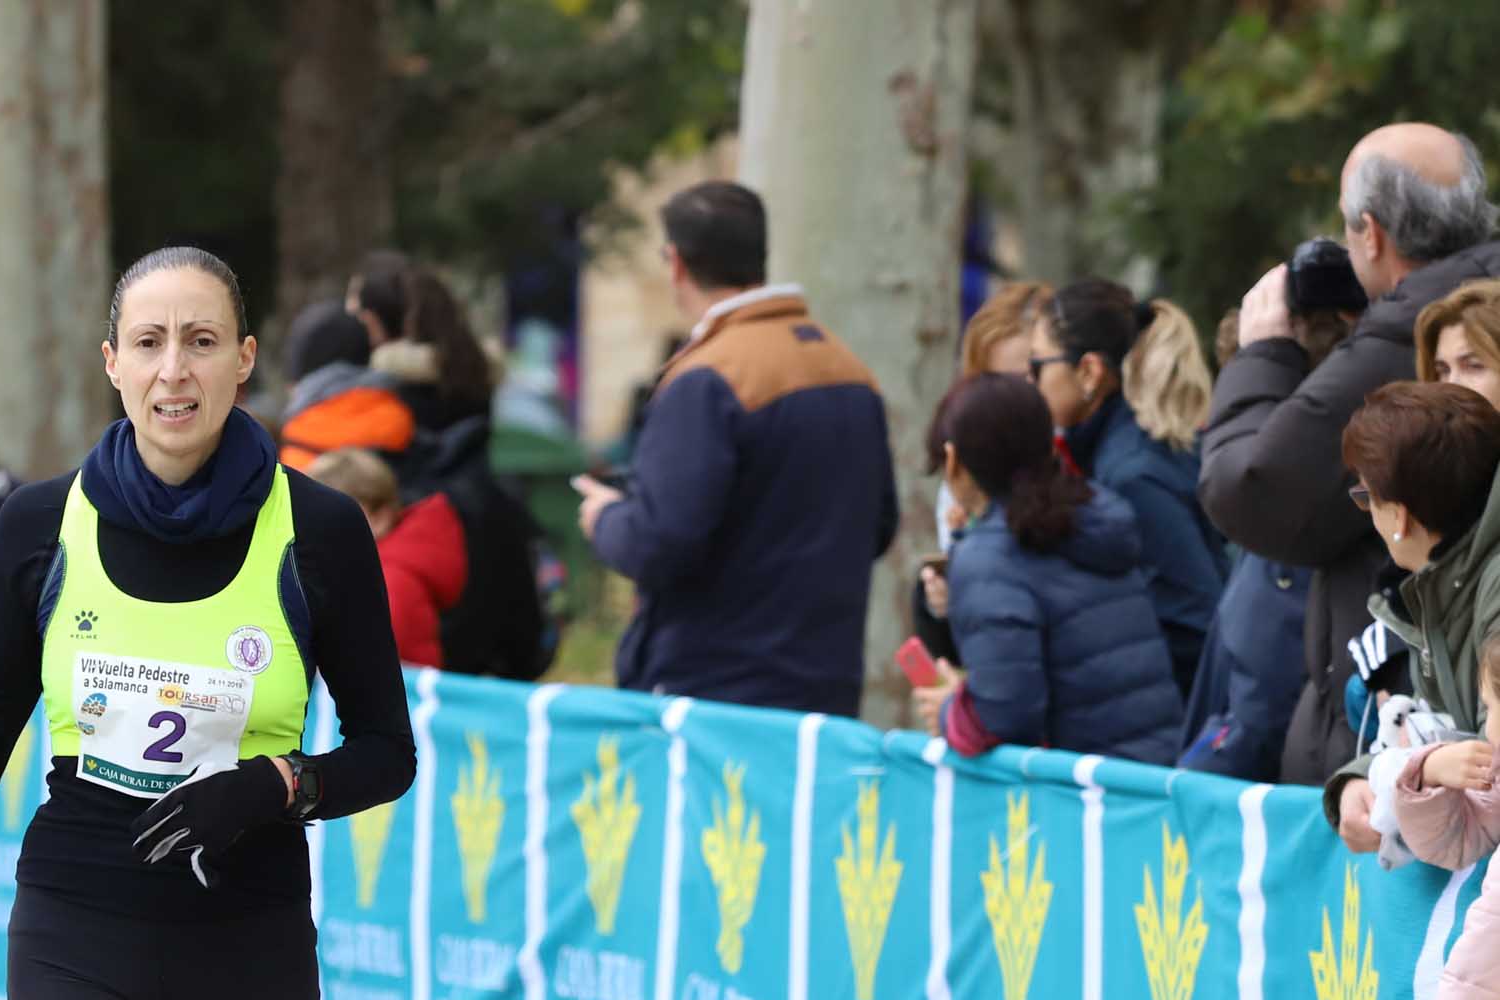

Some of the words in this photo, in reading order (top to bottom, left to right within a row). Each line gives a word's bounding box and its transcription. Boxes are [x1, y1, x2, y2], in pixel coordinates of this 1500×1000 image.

[98, 659, 135, 678] Vuelta
[138, 665, 190, 685] Pedestre
[84, 677, 90, 688] a
[92, 676, 148, 694] Salamanca
[142, 710, 187, 763] 2
[99, 766, 118, 780] CAJA
[120, 773, 149, 788] RURAL
[150, 780, 165, 789] DE
